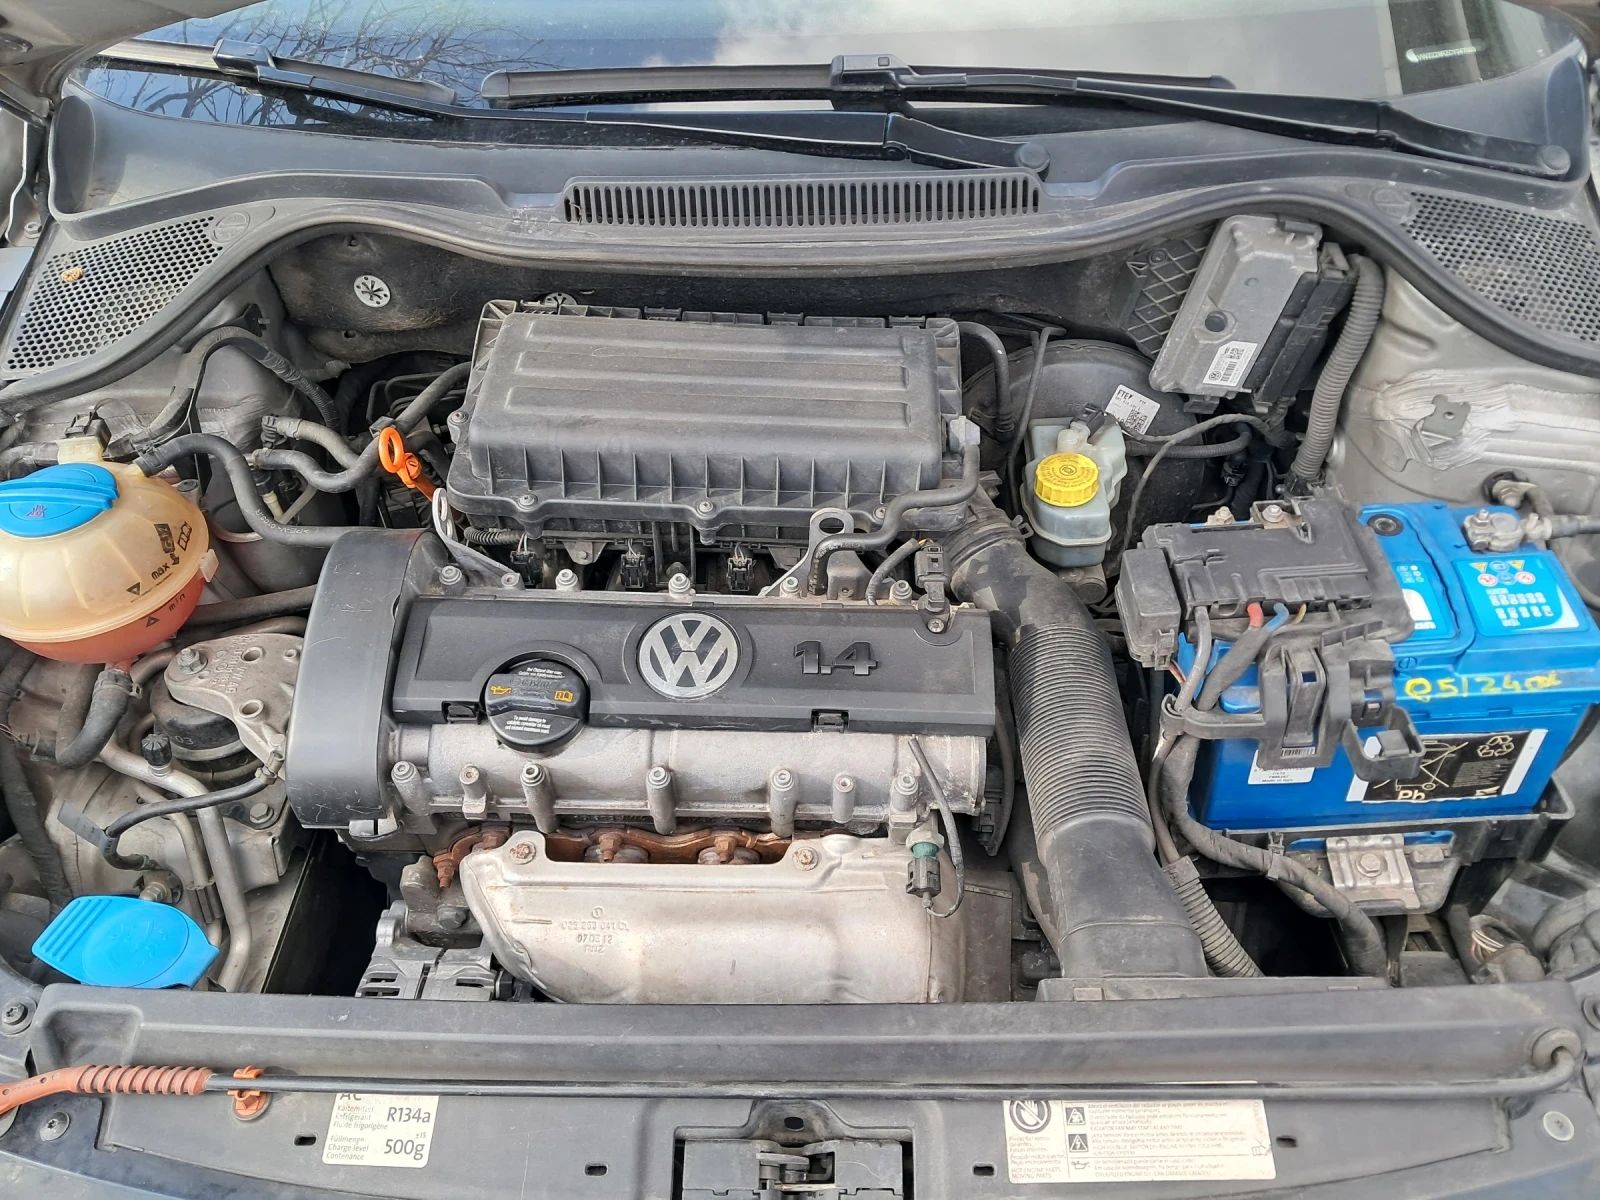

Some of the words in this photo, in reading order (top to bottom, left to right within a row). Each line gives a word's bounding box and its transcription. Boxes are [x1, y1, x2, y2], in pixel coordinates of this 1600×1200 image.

[151, 562, 170, 581] max
[168, 593, 186, 612] min
[794, 640, 878, 676] 1.4
[1397, 790, 1425, 801] Pb
[386, 1107, 431, 1123] R134a
[328, 1143, 352, 1153] Charge
[353, 1144, 369, 1152] level
[384, 1139, 425, 1160] 500g
